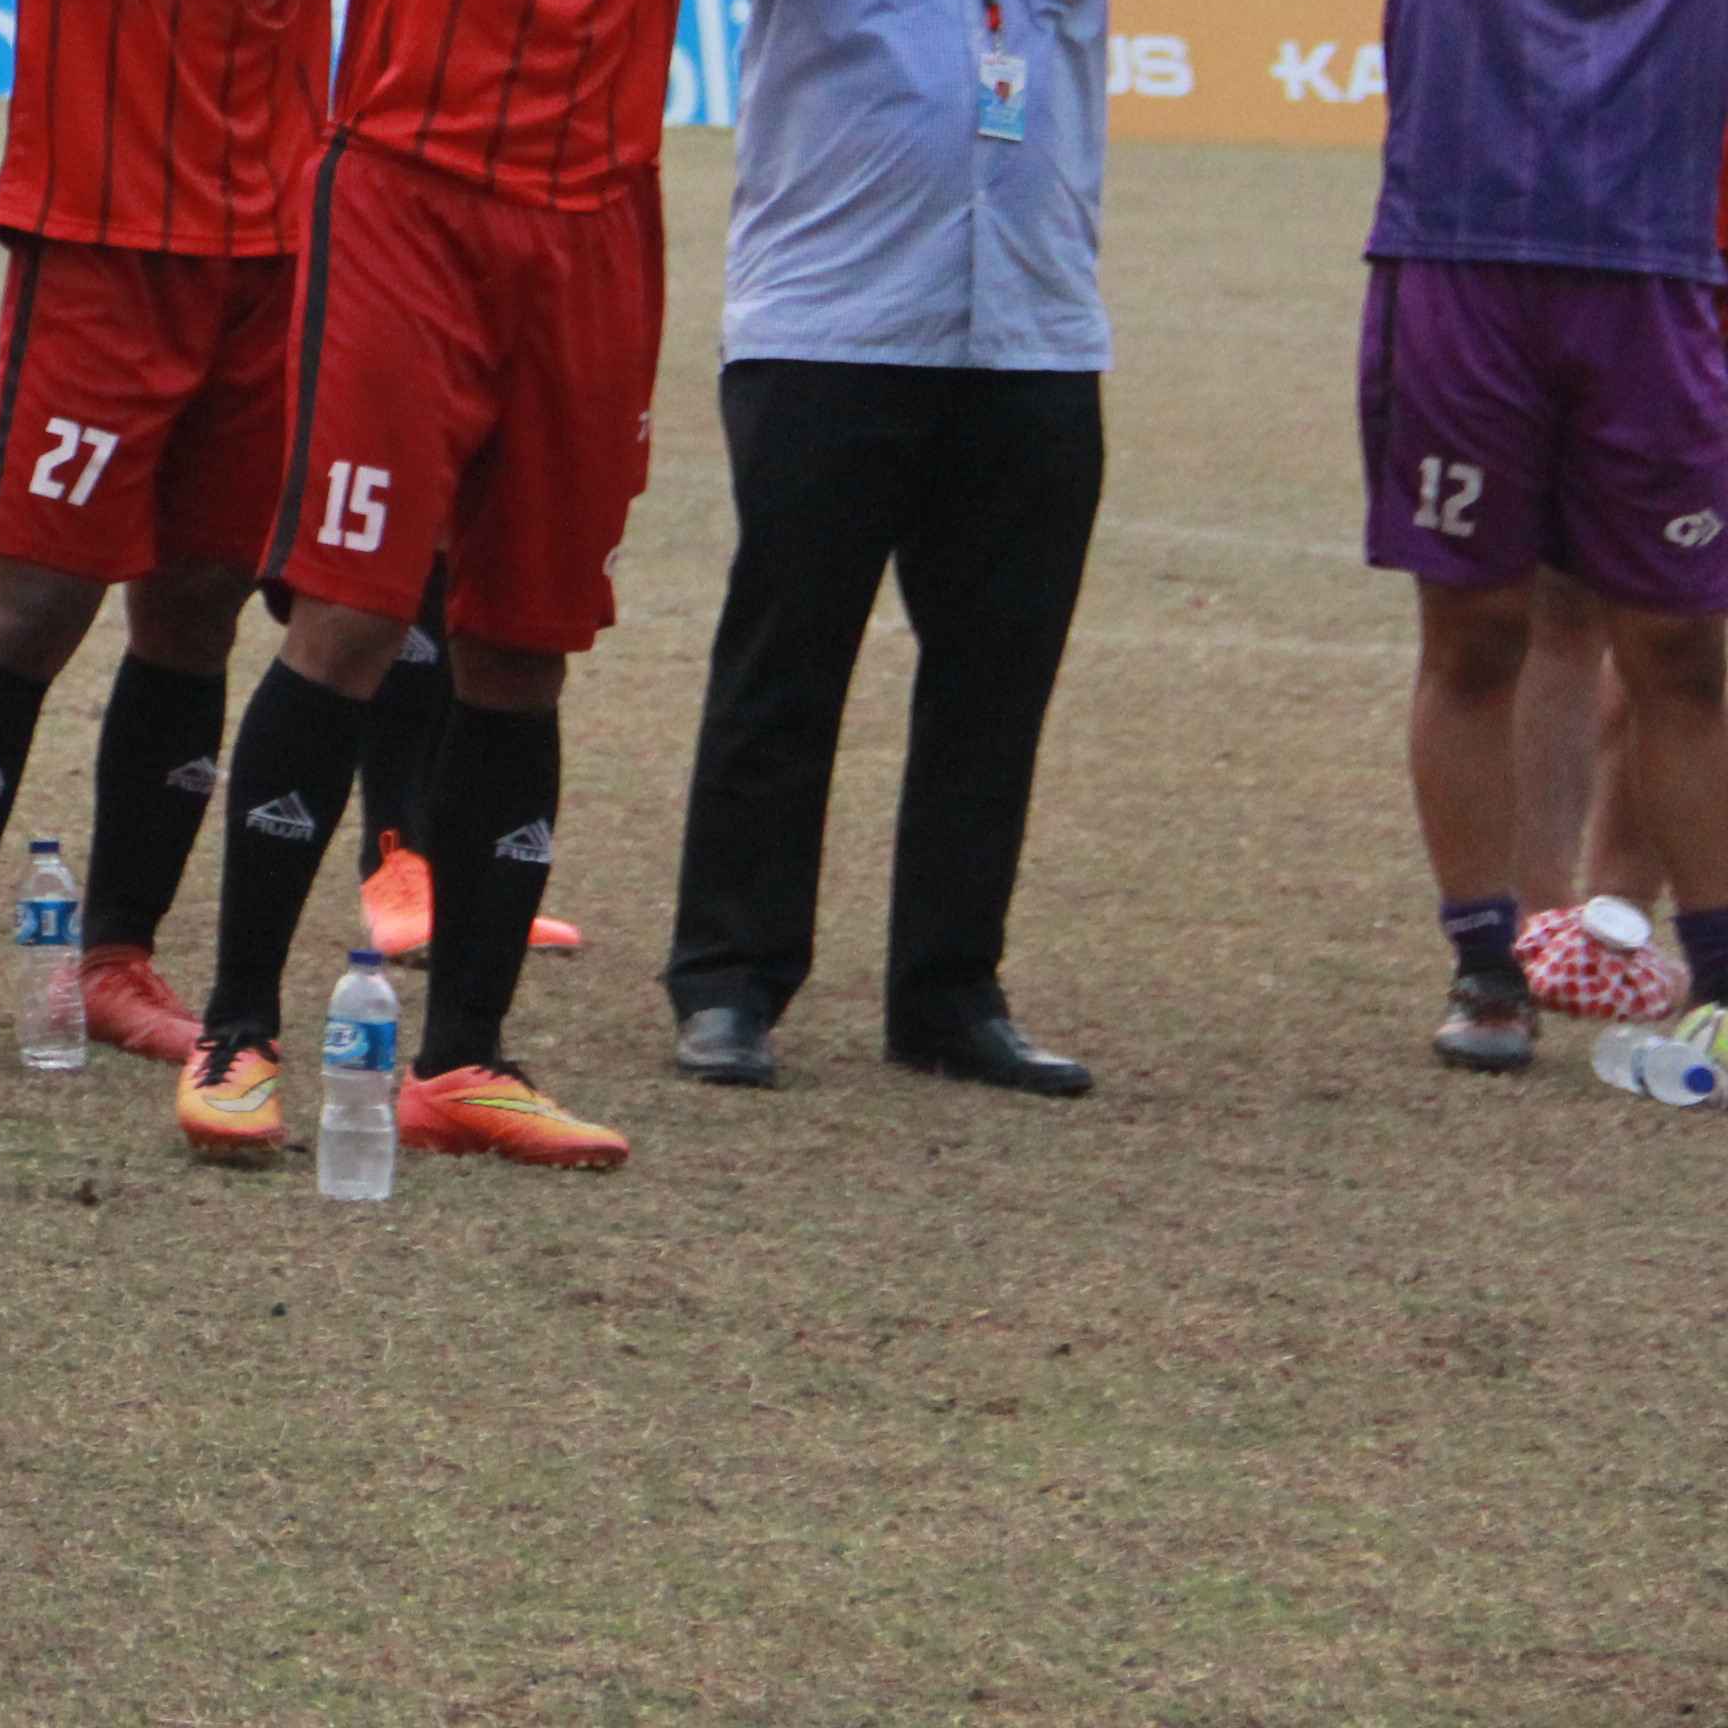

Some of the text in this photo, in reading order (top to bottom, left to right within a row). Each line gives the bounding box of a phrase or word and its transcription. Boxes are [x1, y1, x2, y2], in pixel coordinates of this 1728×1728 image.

[28, 416, 119, 507] 27
[316, 459, 391, 554] 15
[1412, 456, 1484, 538] 12
